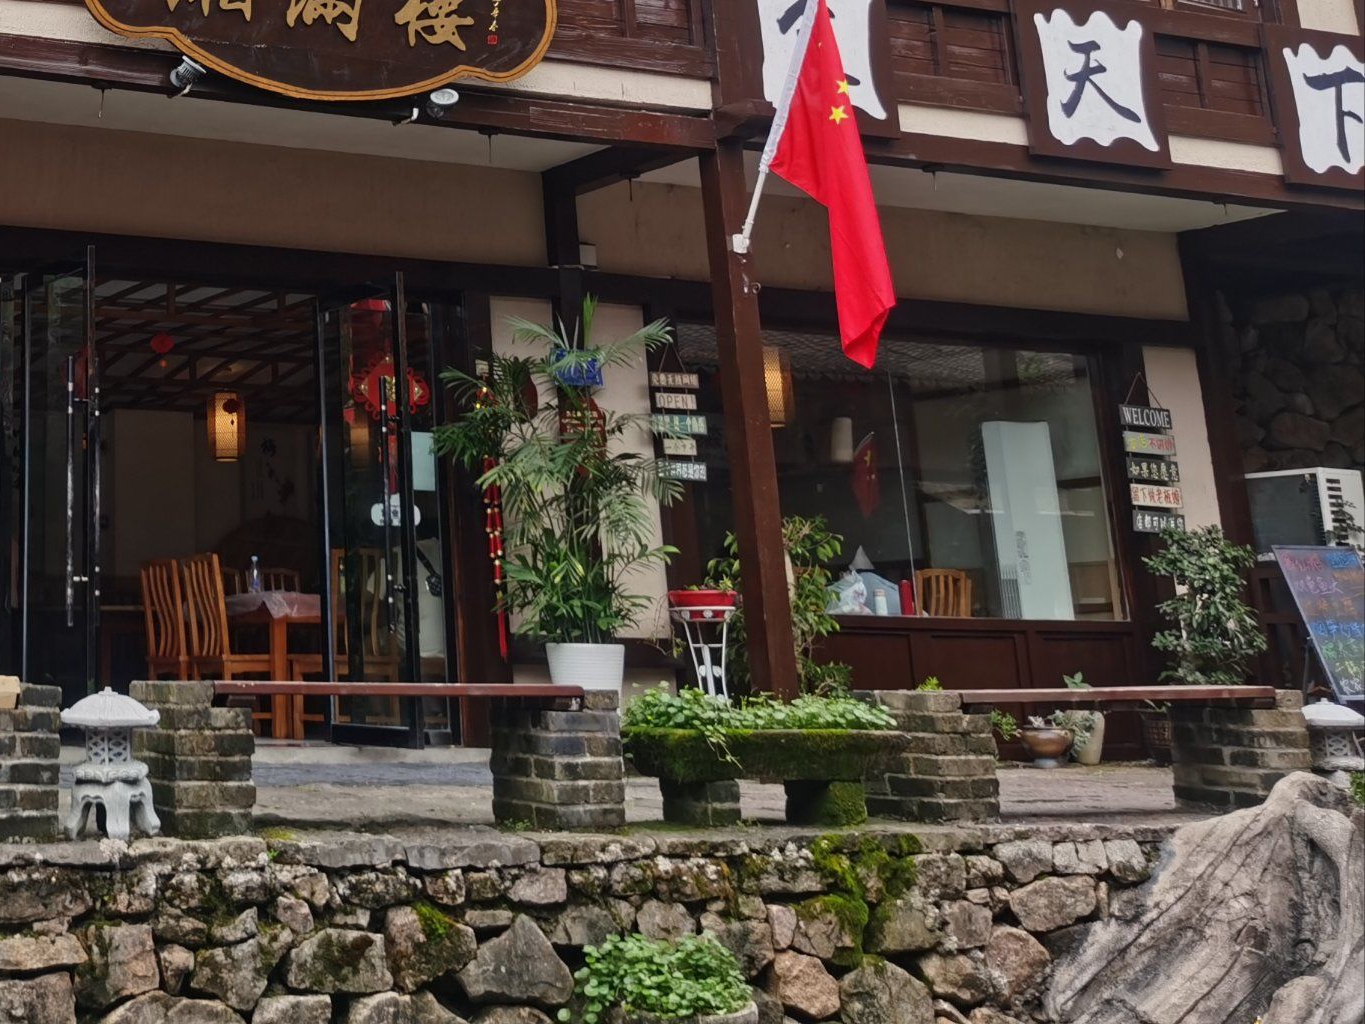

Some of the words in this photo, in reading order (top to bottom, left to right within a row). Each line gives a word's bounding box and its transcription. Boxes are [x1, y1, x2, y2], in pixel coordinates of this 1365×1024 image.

[1060, 40, 1141, 124] 天
[1302, 66, 1365, 163] 下
[1122, 407, 1170, 428] WELCOME
